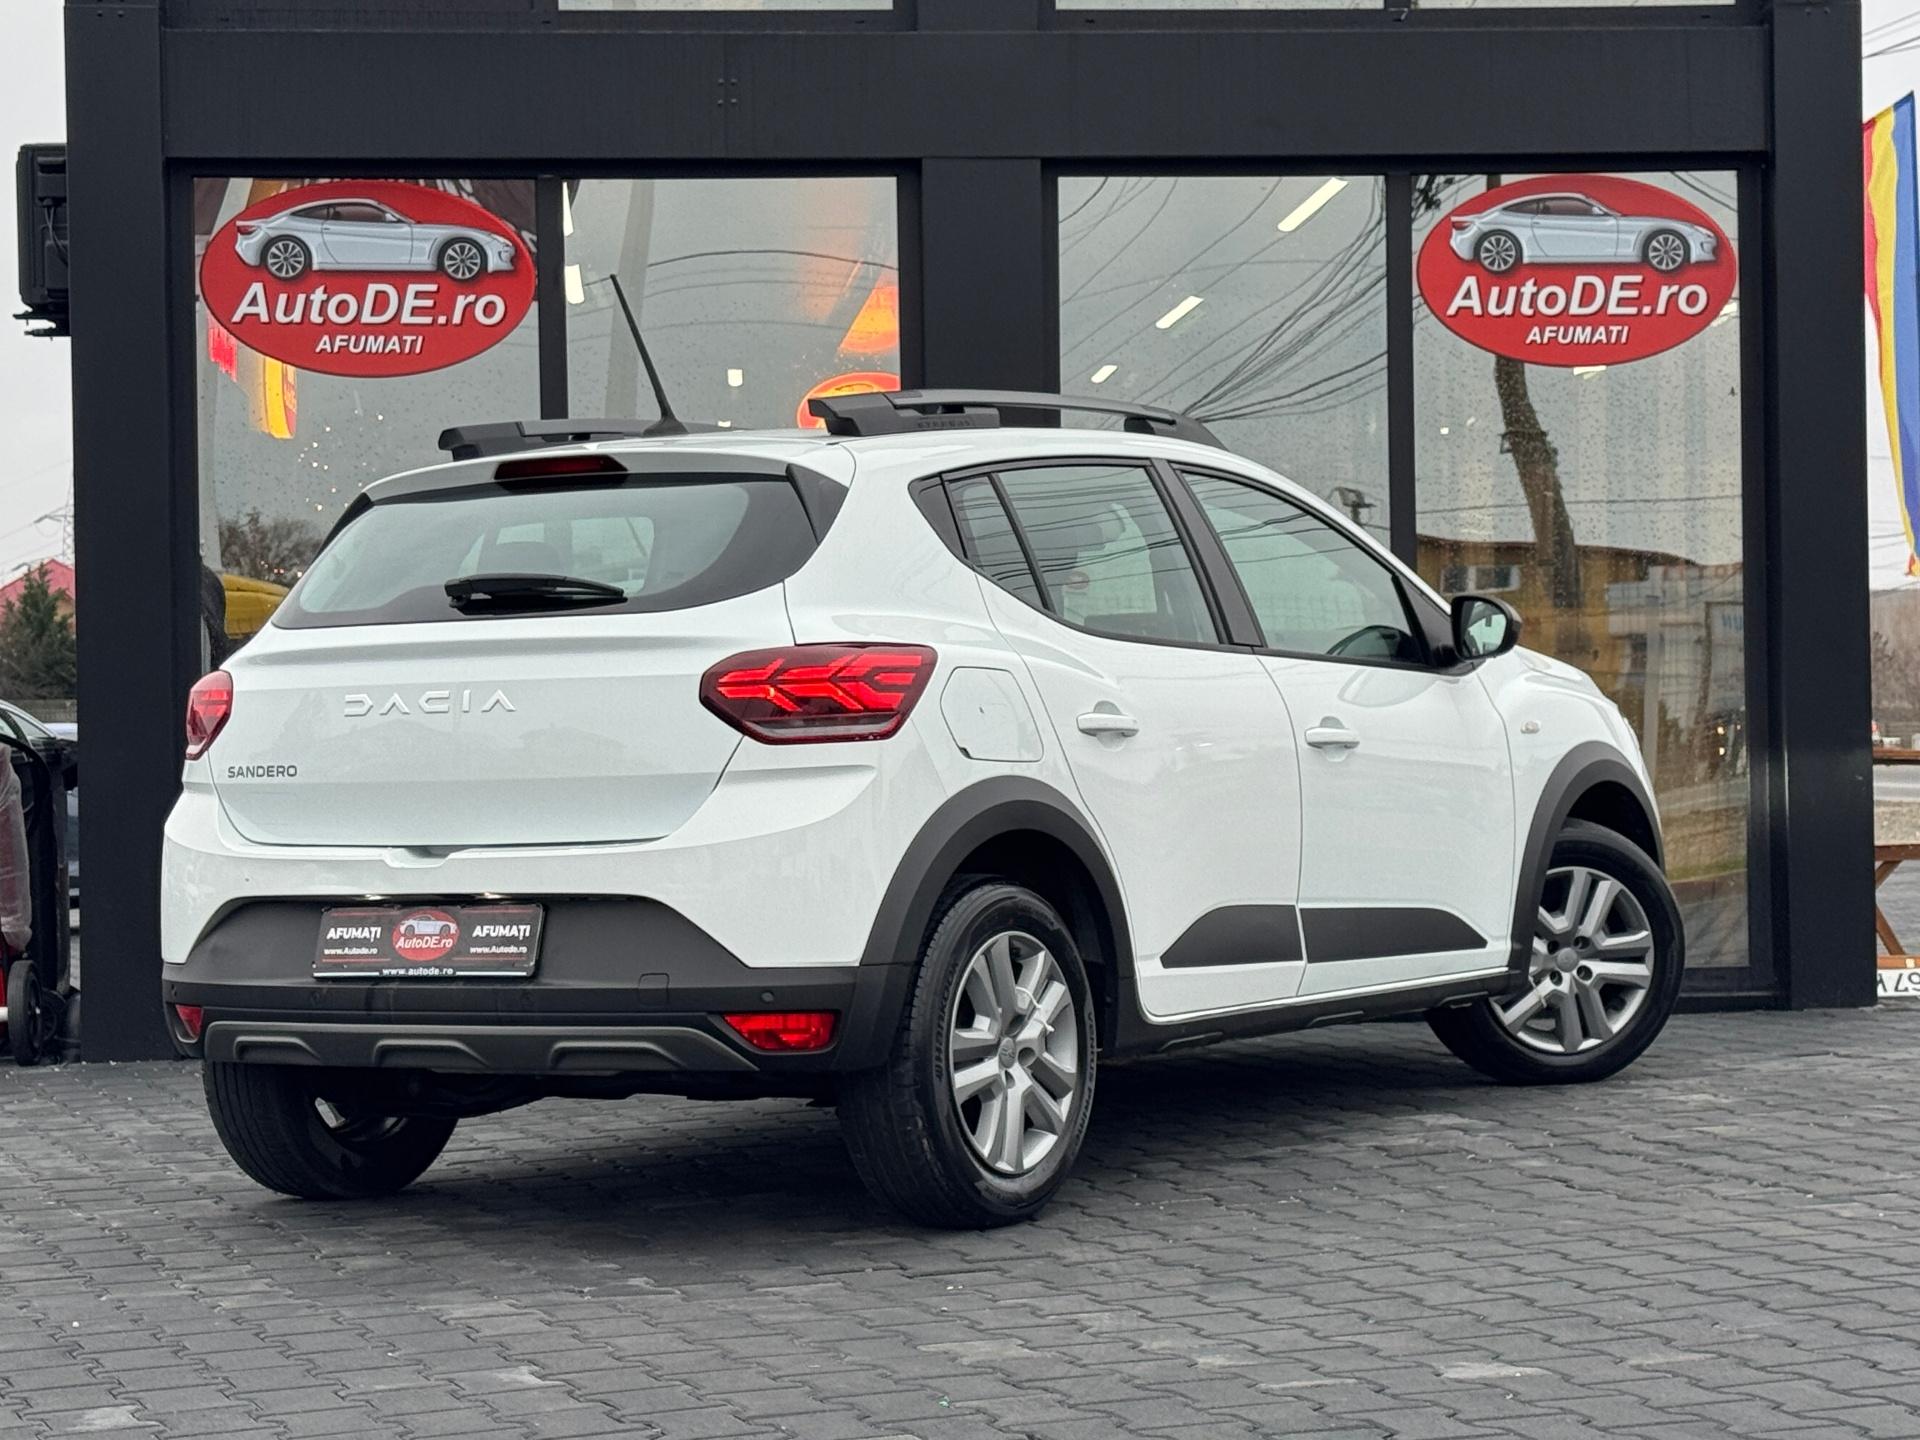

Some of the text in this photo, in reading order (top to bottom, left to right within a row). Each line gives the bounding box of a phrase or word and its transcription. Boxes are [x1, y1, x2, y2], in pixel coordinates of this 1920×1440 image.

[231, 281, 506, 326] AutoDE.ro
[1446, 274, 1708, 317] AutoDE.ro
[315, 334, 424, 355] AFUMATI
[1525, 325, 1630, 345] AFUMATI
[344, 688, 517, 717] DACIA
[227, 764, 298, 778] SANDERO
[395, 935, 454, 951] AutoDE.ro
[382, 965, 454, 977] www.autode.ro
